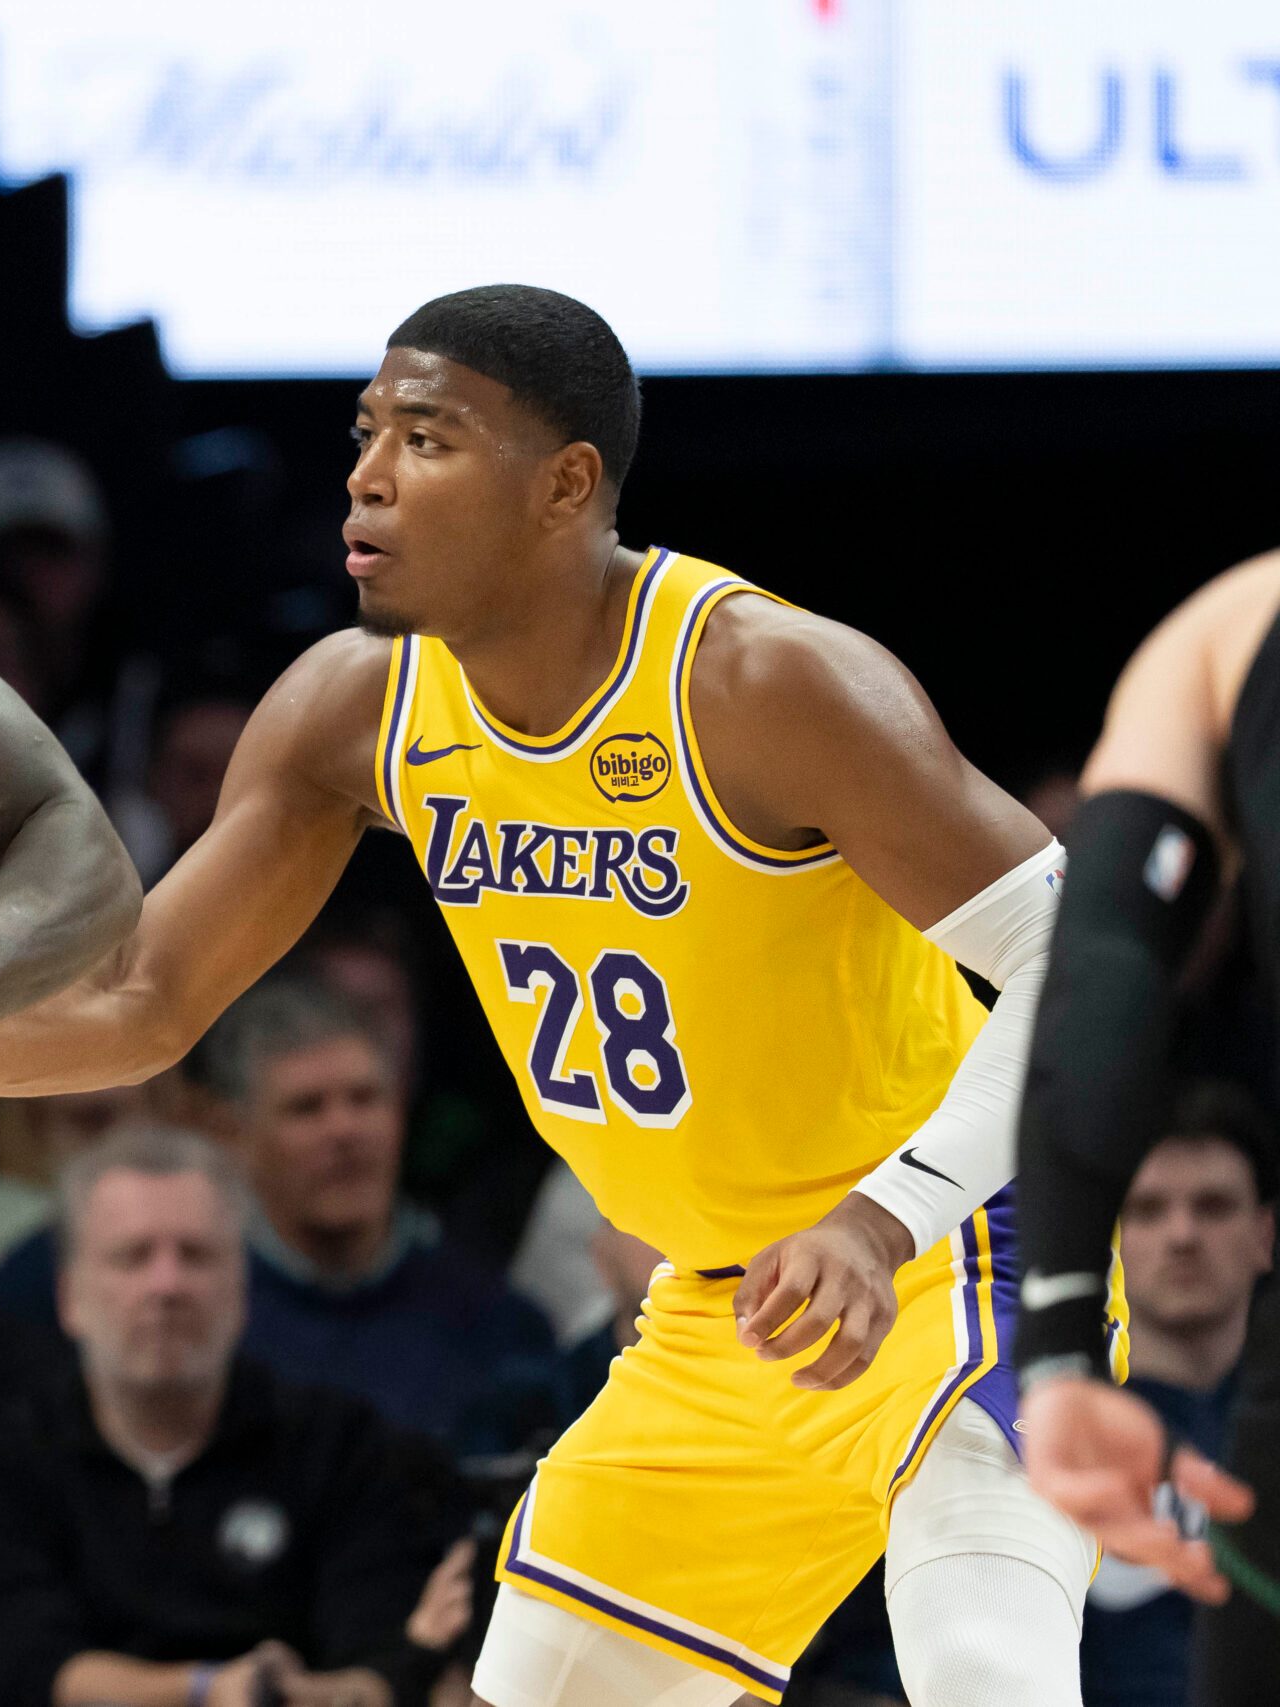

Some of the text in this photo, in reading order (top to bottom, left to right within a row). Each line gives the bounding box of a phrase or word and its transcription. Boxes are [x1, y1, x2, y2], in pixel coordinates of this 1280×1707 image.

[597, 751, 666, 781] bibigo
[611, 775, 639, 787] 비비고
[421, 794, 690, 920] LAKERS
[496, 938, 693, 1129] 28
